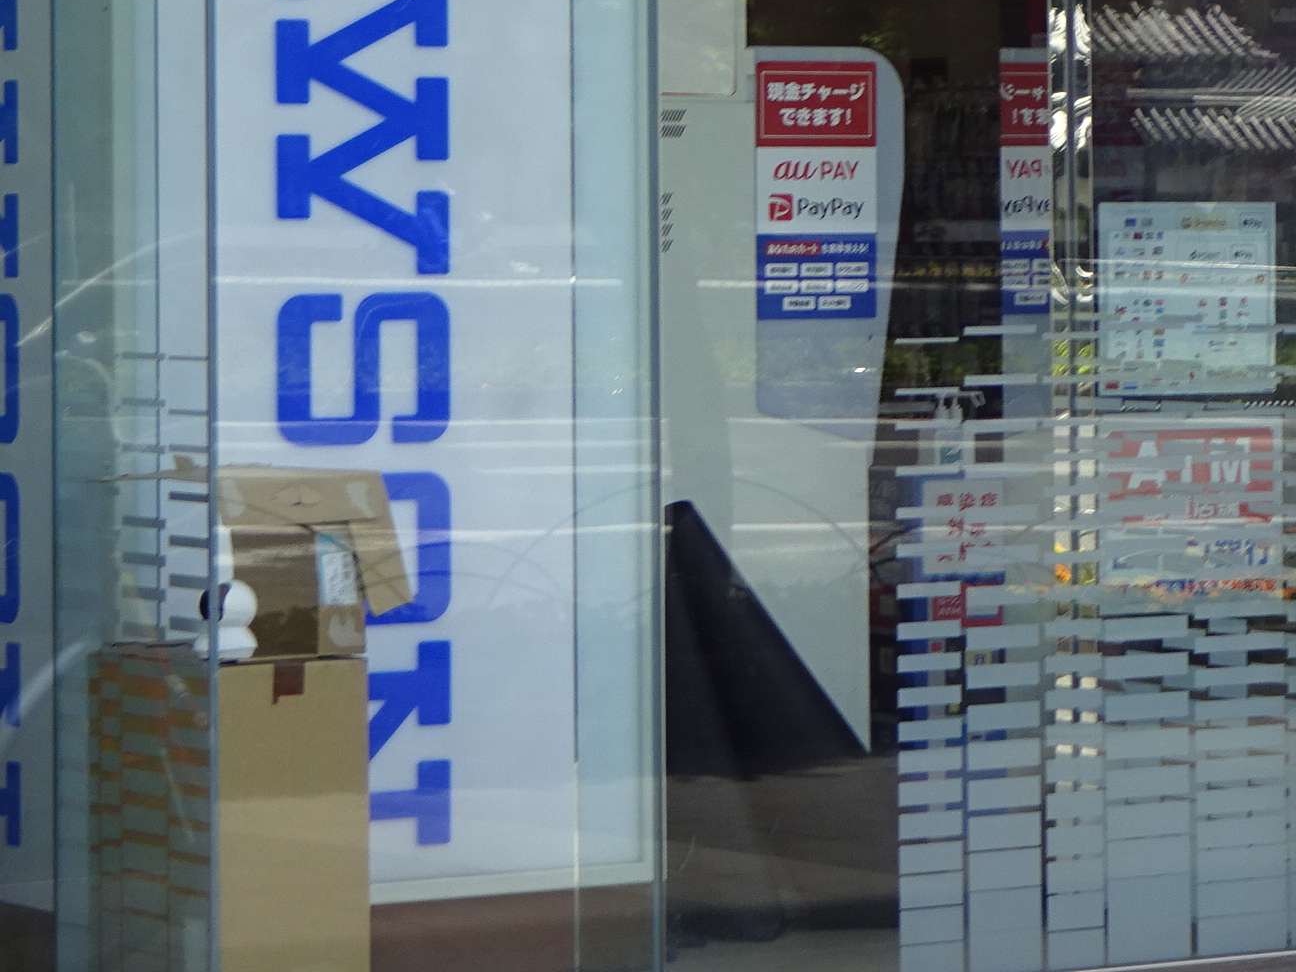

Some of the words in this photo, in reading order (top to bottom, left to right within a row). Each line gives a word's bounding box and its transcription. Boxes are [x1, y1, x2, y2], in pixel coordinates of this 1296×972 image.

[766, 81, 866, 103] 現金チャージ
[778, 107, 853, 127] できます!
[773, 160, 819, 182] au
[820, 159, 861, 182] PAY
[796, 196, 866, 221] PayPay
